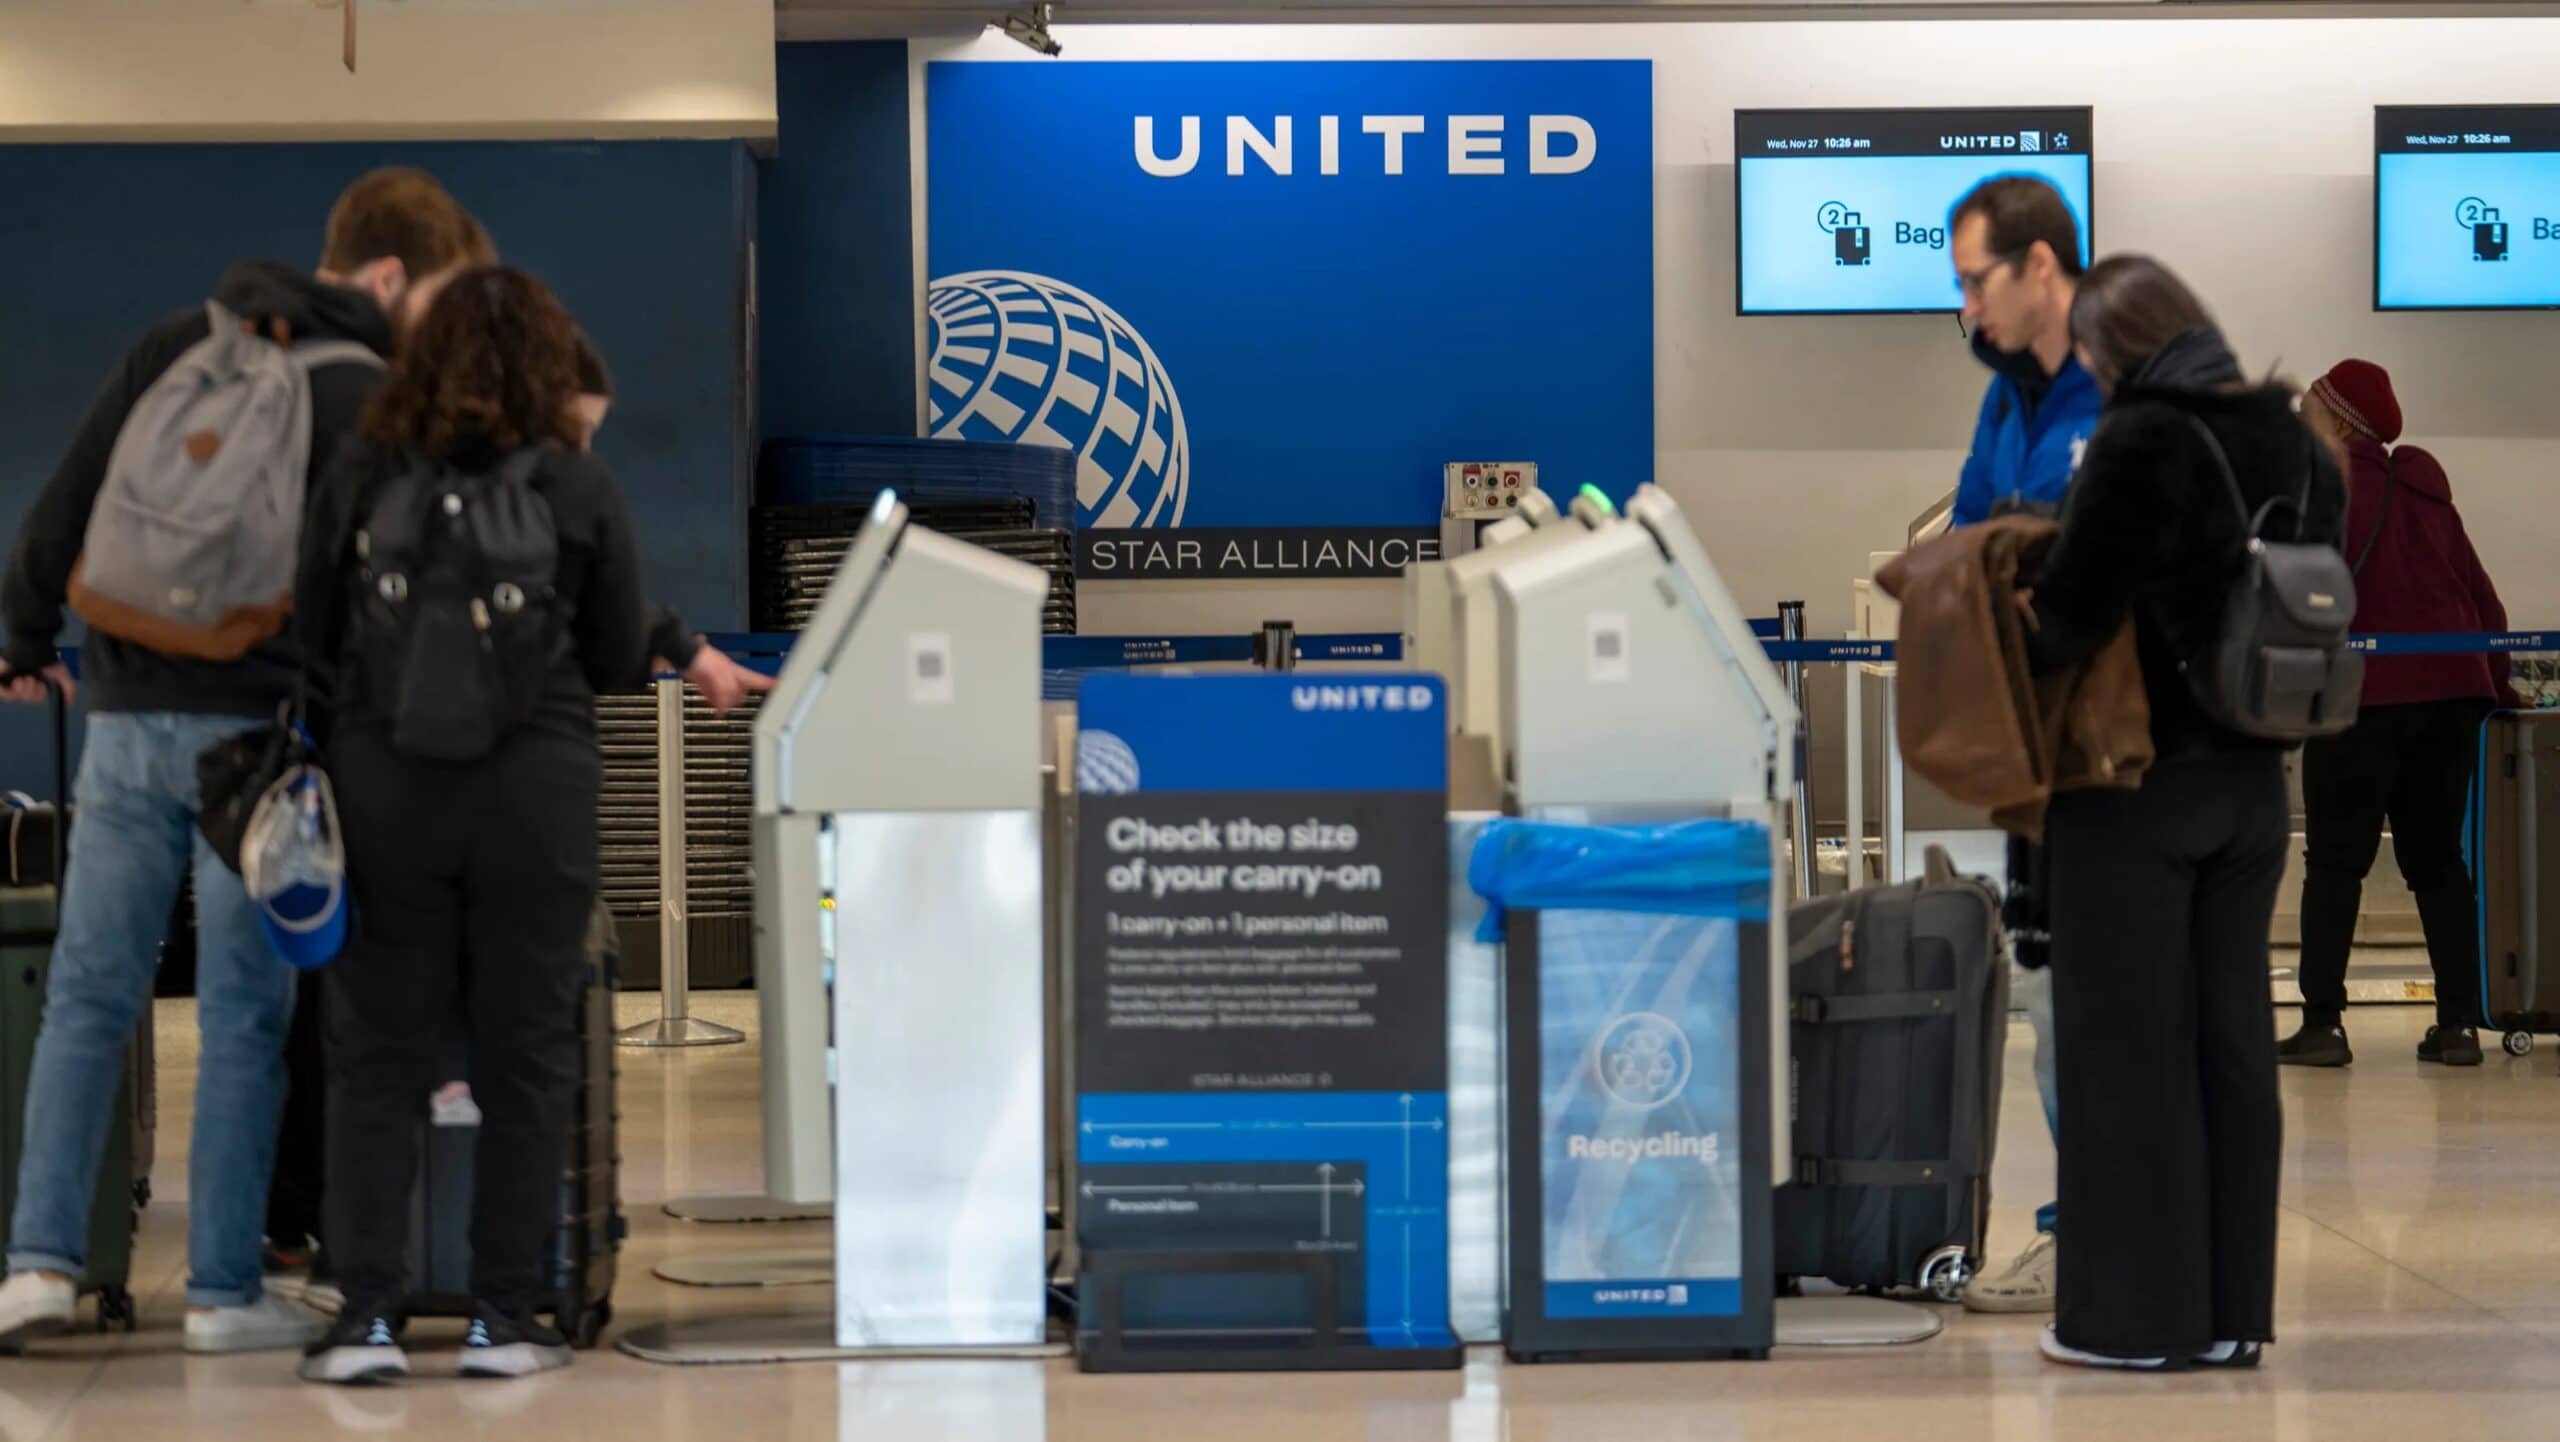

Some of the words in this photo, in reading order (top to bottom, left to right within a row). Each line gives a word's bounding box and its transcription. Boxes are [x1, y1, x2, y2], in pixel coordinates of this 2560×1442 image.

[1134, 114, 1597, 177] UNITED
[1767, 138, 1787, 149] Wed,
[1789, 138, 1806, 148] Nov
[1807, 138, 1818, 148] 27
[1824, 137, 1851, 149] 10:26
[1853, 139, 1870, 149] am
[1940, 135, 2016, 148] UNITED
[2406, 135, 2428, 145] Wed,
[2429, 135, 2445, 144] Nov
[2446, 135, 2458, 144] 27
[2463, 134, 2491, 144] 10:26
[2492, 135, 2511, 144] am
[1895, 222, 1944, 250] Bag
[1091, 540, 1202, 570] STAR
[1219, 538, 1440, 570] ALLIANCE
[1331, 645, 1372, 655] UNITED
[1829, 647, 1870, 655] UNITED
[1292, 686, 1433, 711] UNITED
[1107, 817, 1221, 850] Check
[1226, 817, 1285, 850] the
[1289, 817, 1358, 850] size
[1106, 857, 1145, 891] of
[1149, 864, 1228, 899] your
[1231, 864, 1381, 898] carry-on
[1120, 914, 1213, 938] carry-on
[1243, 911, 1337, 938] personal
[1340, 911, 1388, 933] item
[1569, 1131, 1719, 1166] Recycling
[1594, 1289, 1666, 1304] UNITED
